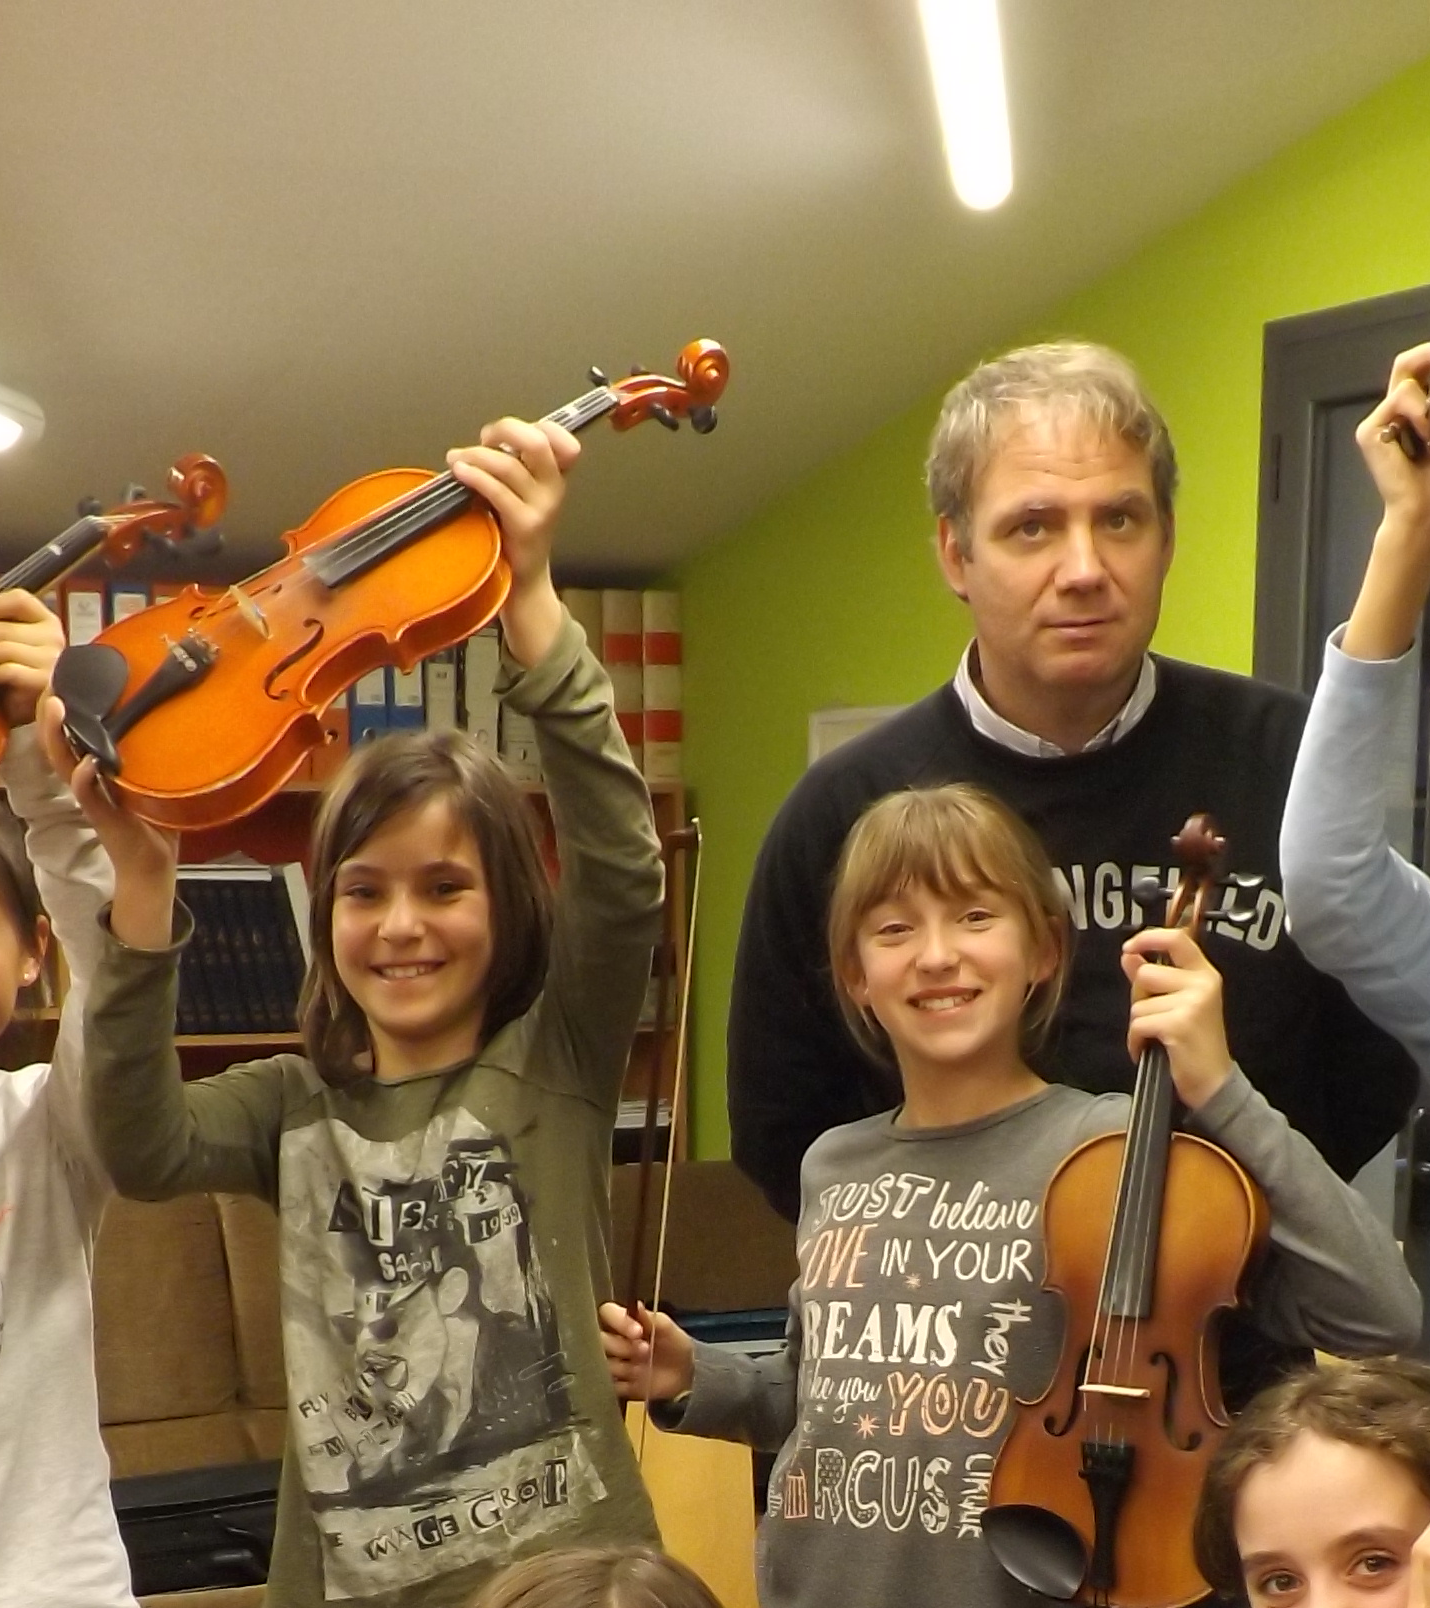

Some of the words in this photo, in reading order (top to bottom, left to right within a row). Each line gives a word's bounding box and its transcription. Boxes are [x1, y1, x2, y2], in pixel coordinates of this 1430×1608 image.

[813, 1172, 936, 1233] JUST
[928, 1180, 1040, 1231] believe
[799, 1223, 879, 1291] OVE
[879, 1238, 913, 1277] IN
[924, 1238, 1034, 1284] YOUR
[832, 1376, 883, 1424] you
[886, 1371, 1010, 1438] YOU
